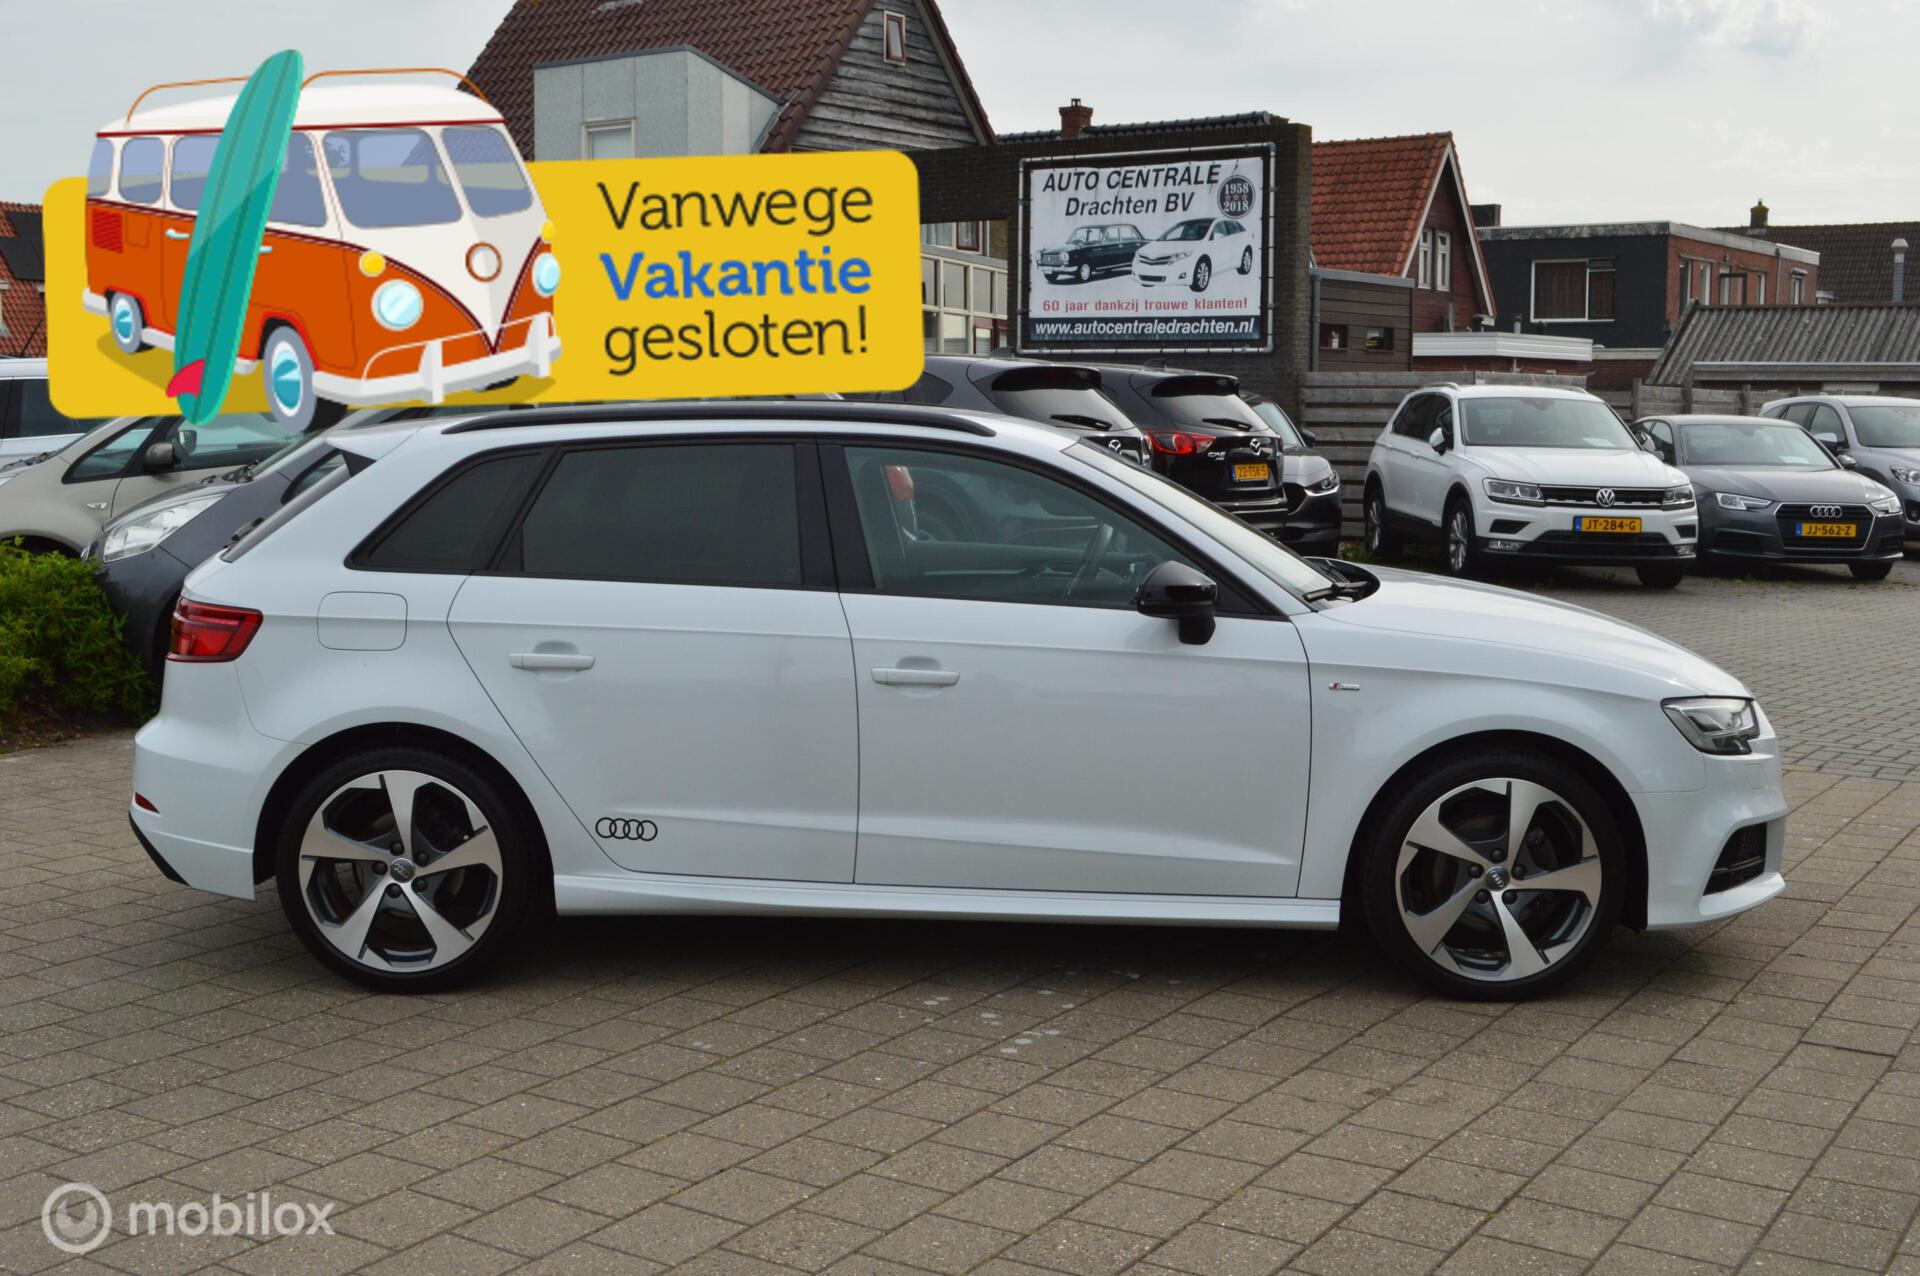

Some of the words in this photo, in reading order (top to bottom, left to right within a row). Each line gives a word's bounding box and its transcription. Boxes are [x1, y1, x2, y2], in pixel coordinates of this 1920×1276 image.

[1043, 170, 1099, 192] AUTO
[1106, 164, 1221, 189] CENTRALE
[1225, 182, 1249, 194] 1958
[1065, 195, 1157, 216] Drachten
[1164, 191, 1195, 212] BV
[1223, 200, 1249, 212] 2018
[1043, 300, 1059, 312] 60
[1065, 300, 1089, 313] jaar
[1095, 299, 1139, 312] dankzij
[1144, 299, 1188, 311] trouwe
[1194, 297, 1248, 310] klanten!
[1035, 317, 1254, 335] www.autocentraledrachten.nl
